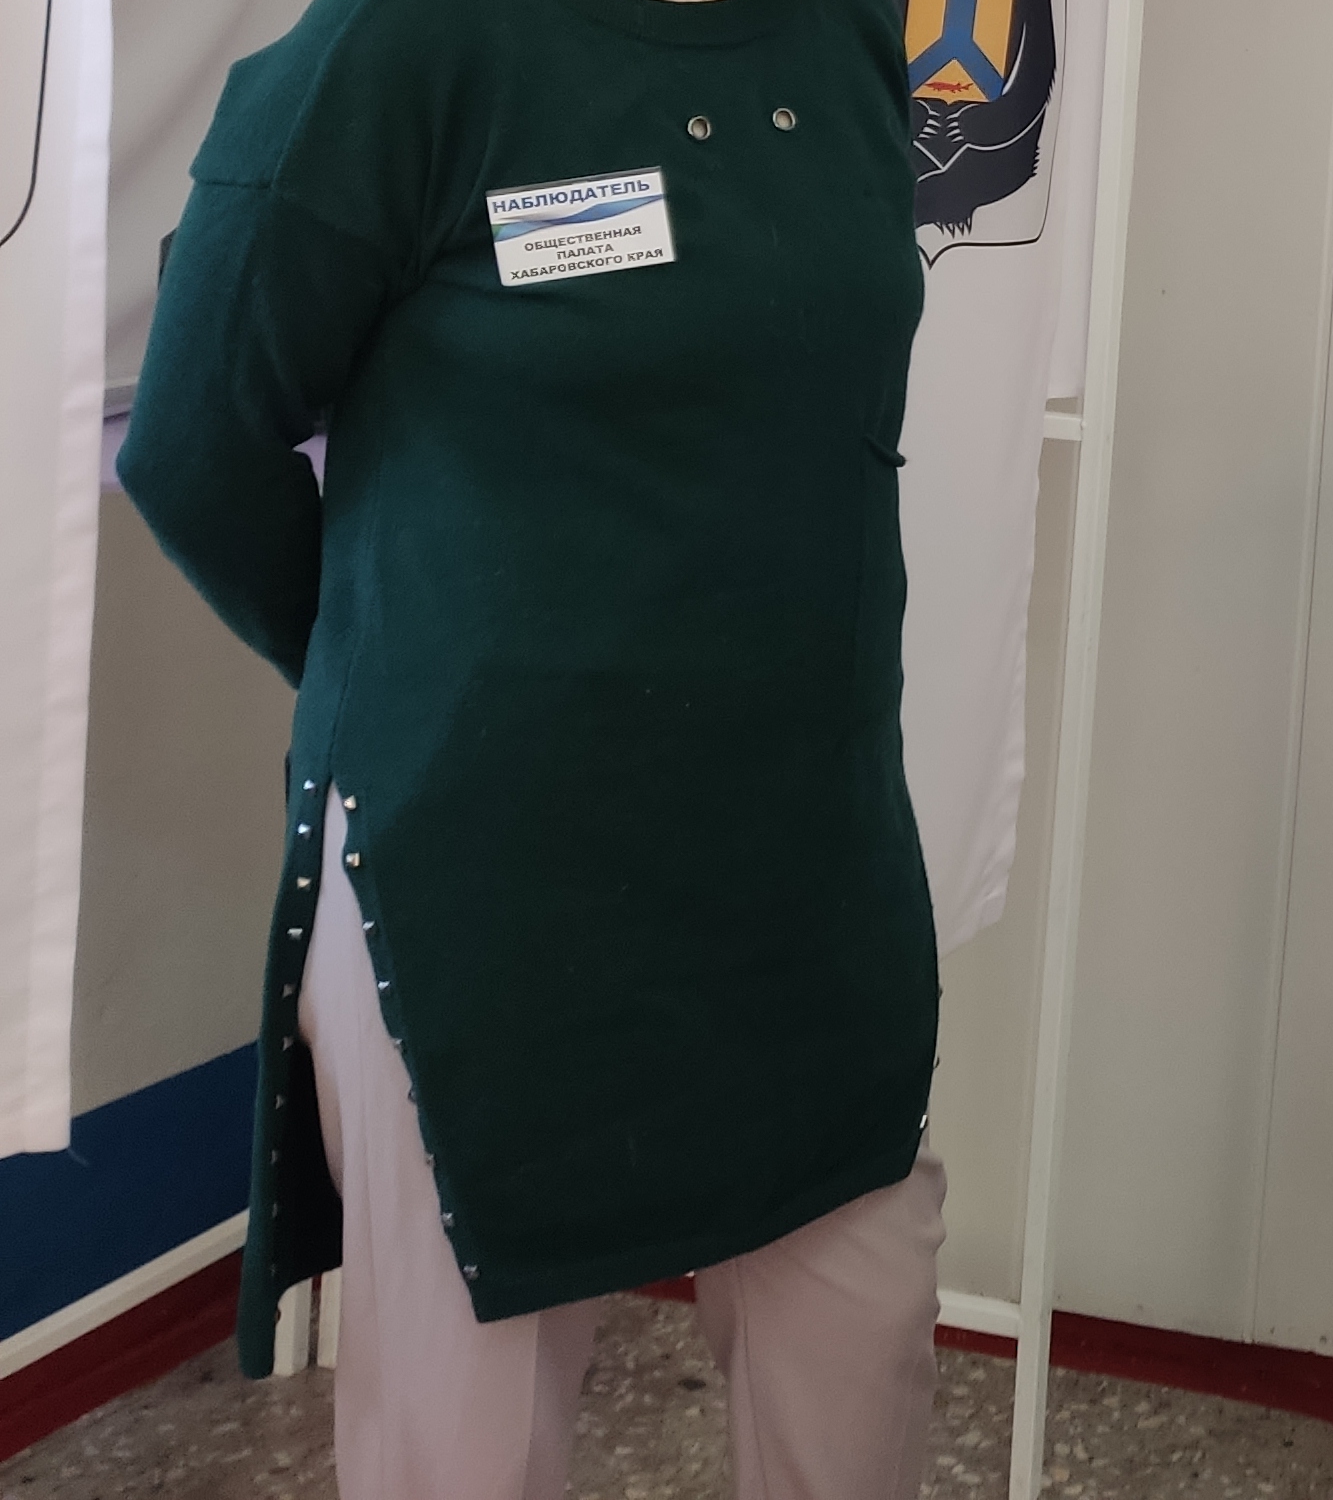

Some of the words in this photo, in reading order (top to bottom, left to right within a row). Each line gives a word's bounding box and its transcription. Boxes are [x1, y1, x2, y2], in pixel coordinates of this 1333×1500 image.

[492, 179, 650, 214] НАБЛЮДАТЕЛЬ
[524, 225, 642, 252] ОБЩЕСТВЕННАЯ
[557, 243, 614, 260] ПАЛАТА
[510, 255, 622, 280] ХАБАРОВСКОГО
[627, 248, 664, 263] КРАЯ
